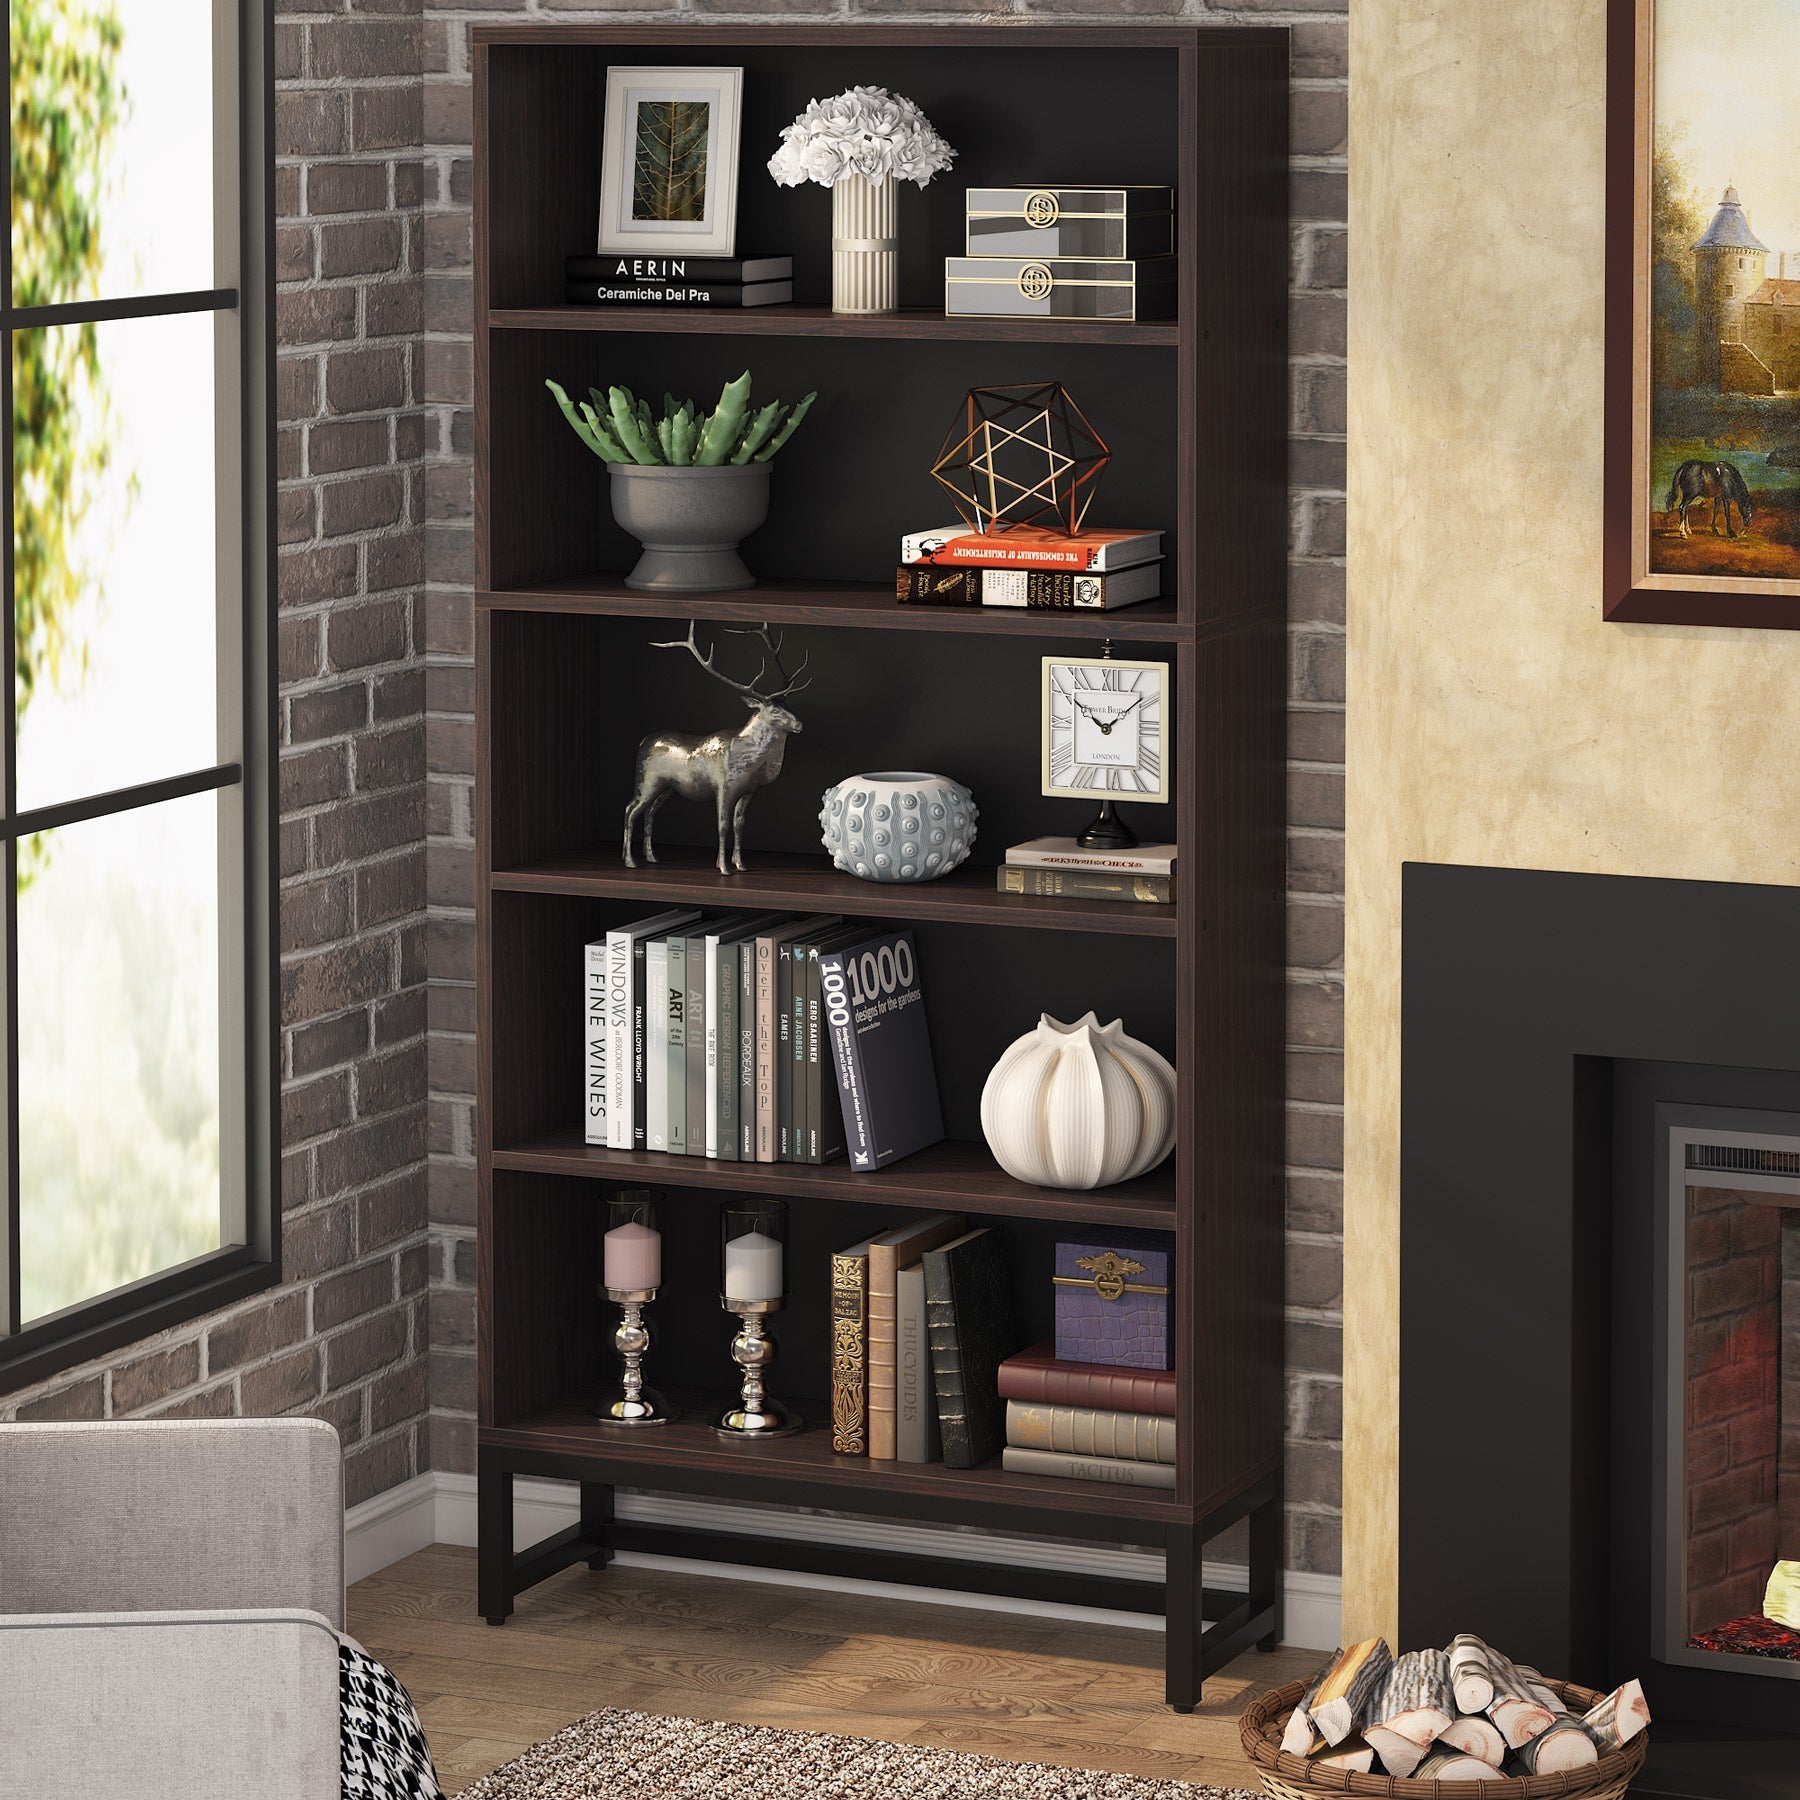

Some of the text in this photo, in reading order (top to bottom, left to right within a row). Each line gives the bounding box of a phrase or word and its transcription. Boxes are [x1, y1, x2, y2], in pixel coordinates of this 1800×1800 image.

[616, 259, 685, 277] AERIN
[598, 287, 710, 301] Ceramiche Del Pra
[953, 547, 1078, 562] THE COMMISSARIAT OF ENLIGHTENMENT
[1062, 575, 1071, 607] Charles
[1092, 753, 1120, 761] LONDON
[611, 940, 626, 1027] WINDOWS
[722, 964, 731, 1010] GRAPHIC
[759, 945, 769, 997] Over
[847, 939, 913, 1006] 1000
[669, 988, 683, 1023] ART
[689, 989, 703, 1025] ART
[821, 962, 850, 1026] 1000
[855, 989, 921, 1023] designs for the gardens
[590, 973, 606, 1117] FINE WINES
[668, 1040, 684, 1048] Century
[722, 1011, 731, 1049] DESIGN
[795, 996, 803, 1061] ARNE JACOBSEN
[810, 1023, 818, 1063] SAARINEN
[615, 1037, 623, 1071] BERGDORF
[741, 1030, 752, 1087] BORDEAUX
[615, 1072, 623, 1110] GOODMAN
[723, 1052, 731, 1119] REFERENCED
[760, 1064, 768, 1108] Top
[904, 1315, 917, 1422] THUCYDIDES
[1068, 1461, 1135, 1482] TACITUS
